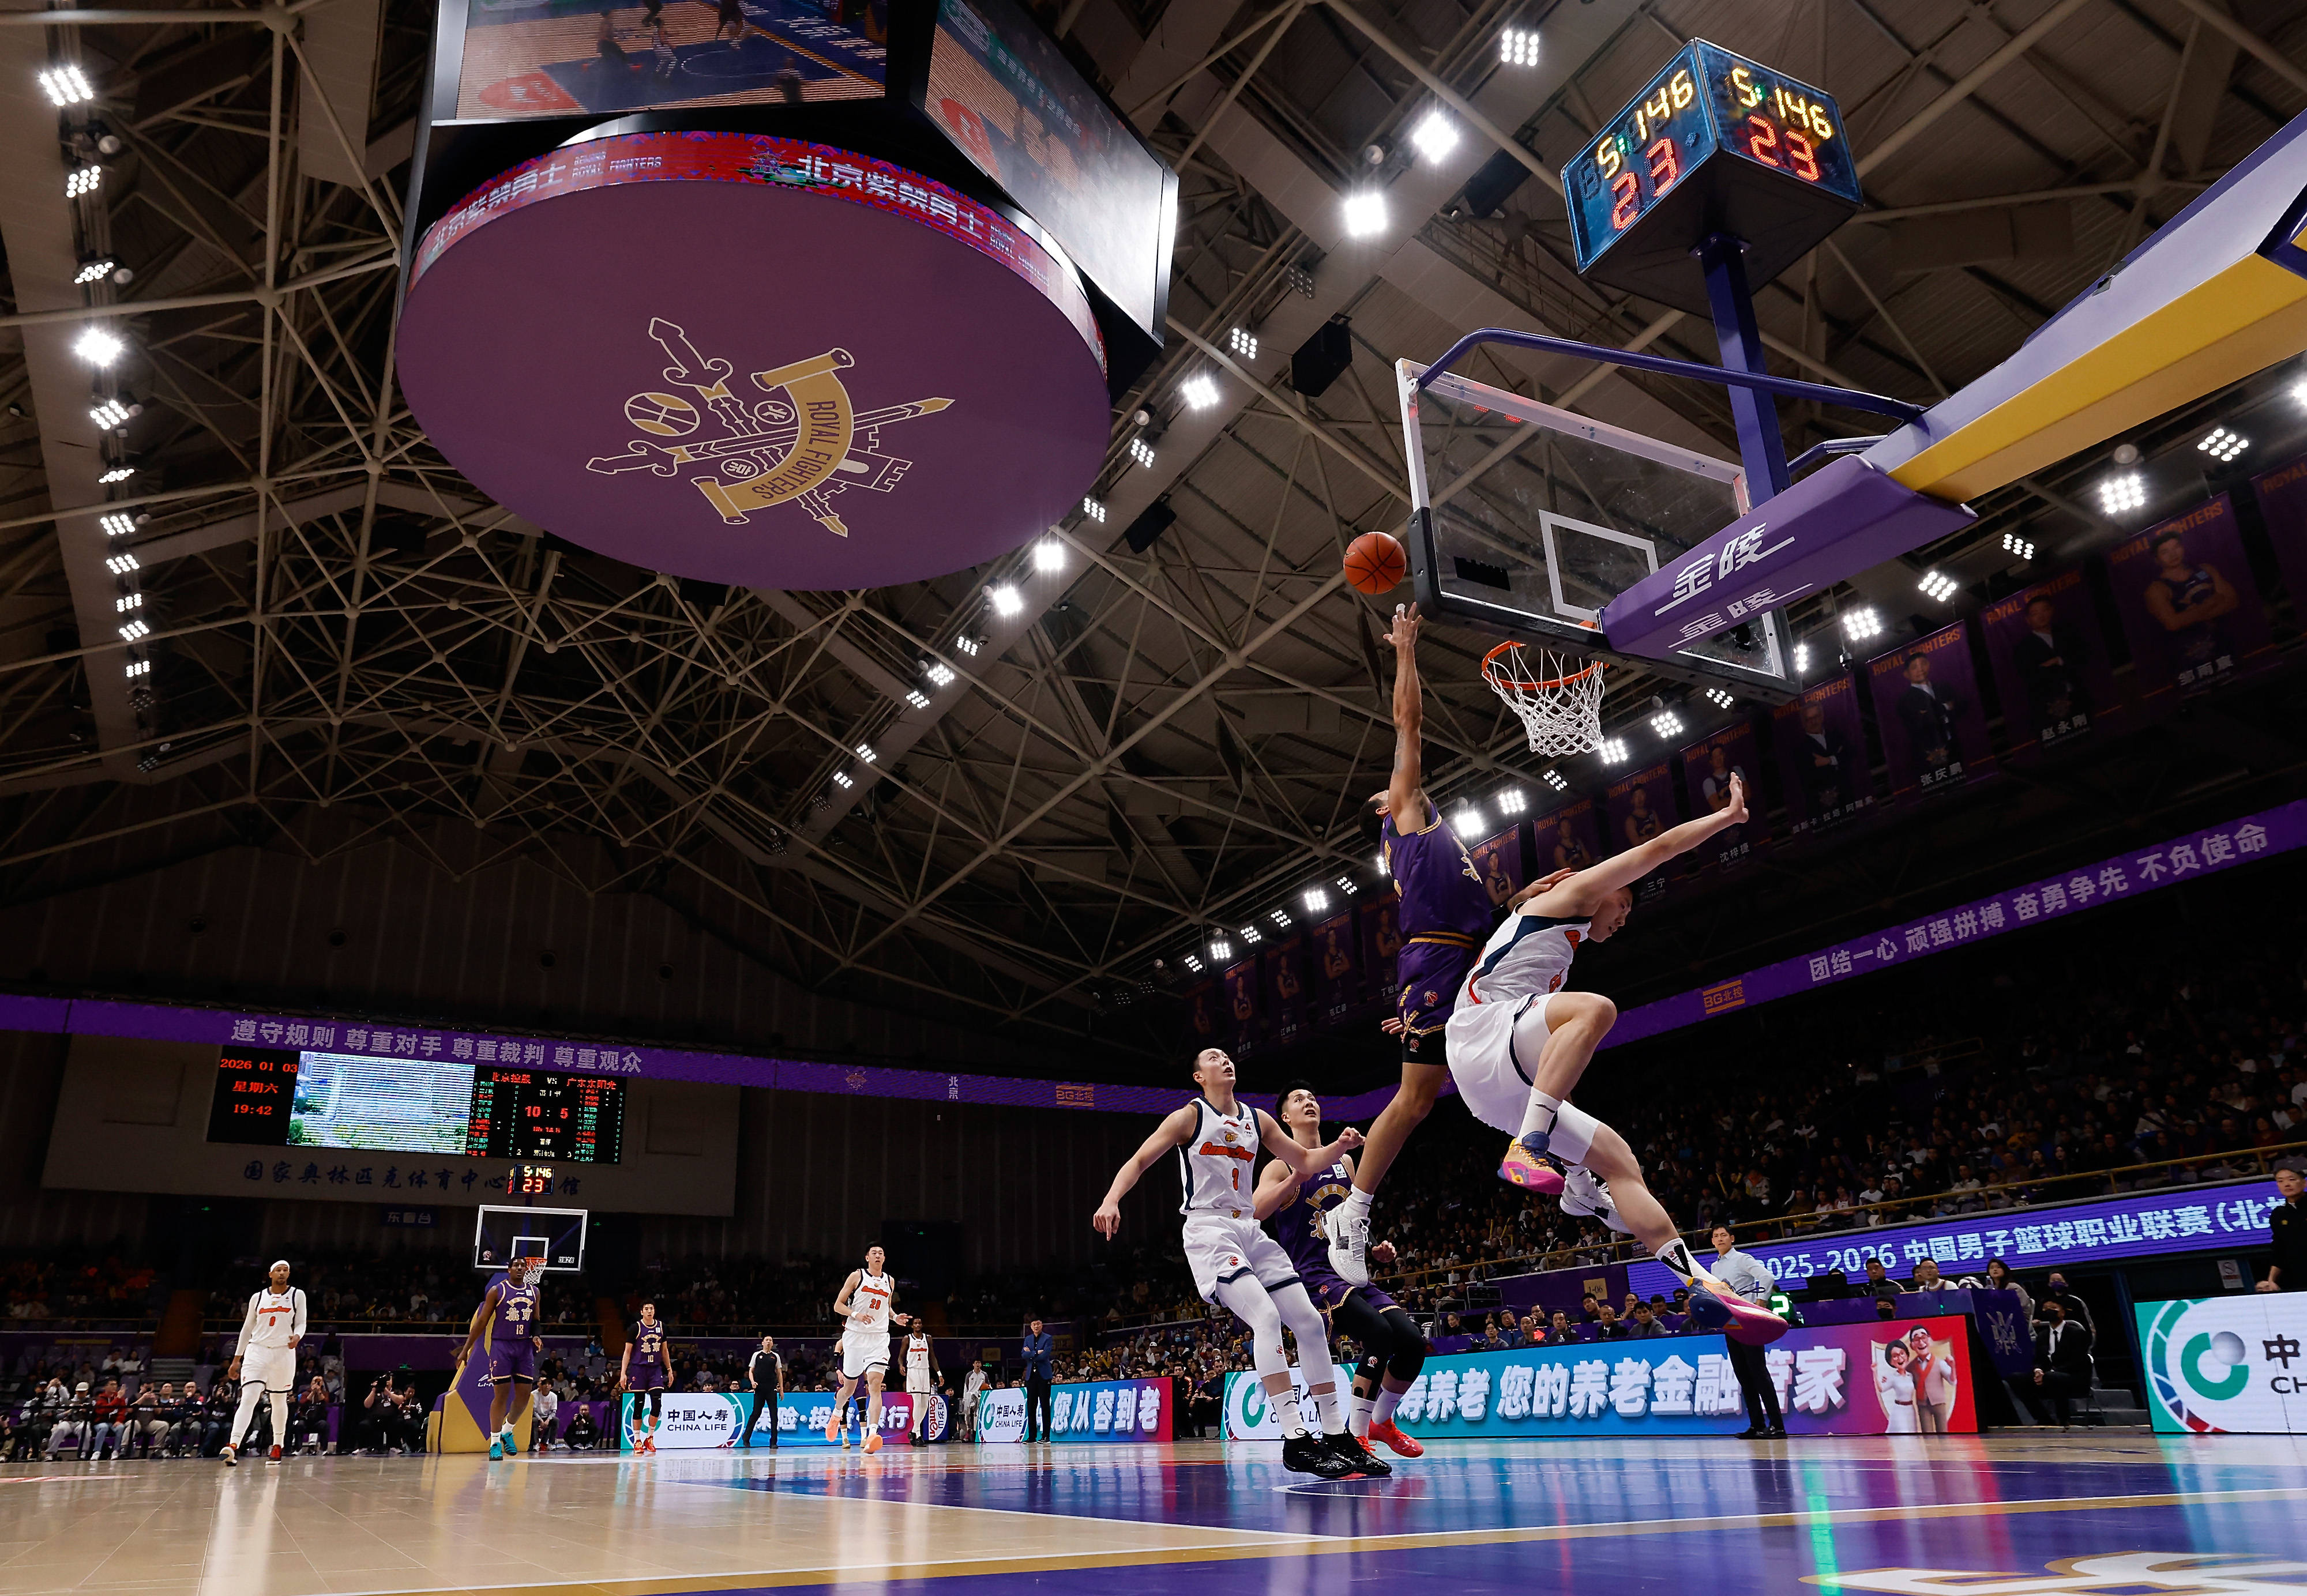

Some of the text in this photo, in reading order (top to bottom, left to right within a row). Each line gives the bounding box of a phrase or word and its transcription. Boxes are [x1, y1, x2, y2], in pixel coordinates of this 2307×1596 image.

[1748, 114, 1820, 182] 23
[797, 155, 985, 239] 北京紫禁勇士
[1611, 137, 1678, 230] 23
[752, 400, 841, 499] ROYAL FIGHTERS
[1655, 522, 1795, 616] 金陵
[1667, 582, 1814, 648] 金陵
[1809, 823, 2268, 982] 团结一心 顽强拼搏 奋勇争先 不负使命
[231, 1019, 642, 1073] 遵守规则 尊重对手 尊重裁判 尊重观众
[220, 1059, 298, 1072] 2026 01 03
[232, 1081, 278, 1094] 星期六
[948, 1076, 959, 1100] 北京
[234, 1104, 272, 1116] 19:42
[524, 1105, 542, 1118] 10
[559, 1107, 570, 1119] 5
[245, 1160, 580, 1196] 国家奥林匹克体育中心馆
[523, 1179, 544, 1192] 23
[1758, 1243, 1895, 1282] 025-2026
[516, 1324, 524, 1335] 13
[647, 1354, 654, 1362] 10
[667, 1409, 728, 1422] 中国人寿
[997, 1404, 1024, 1418] 中国人寿
